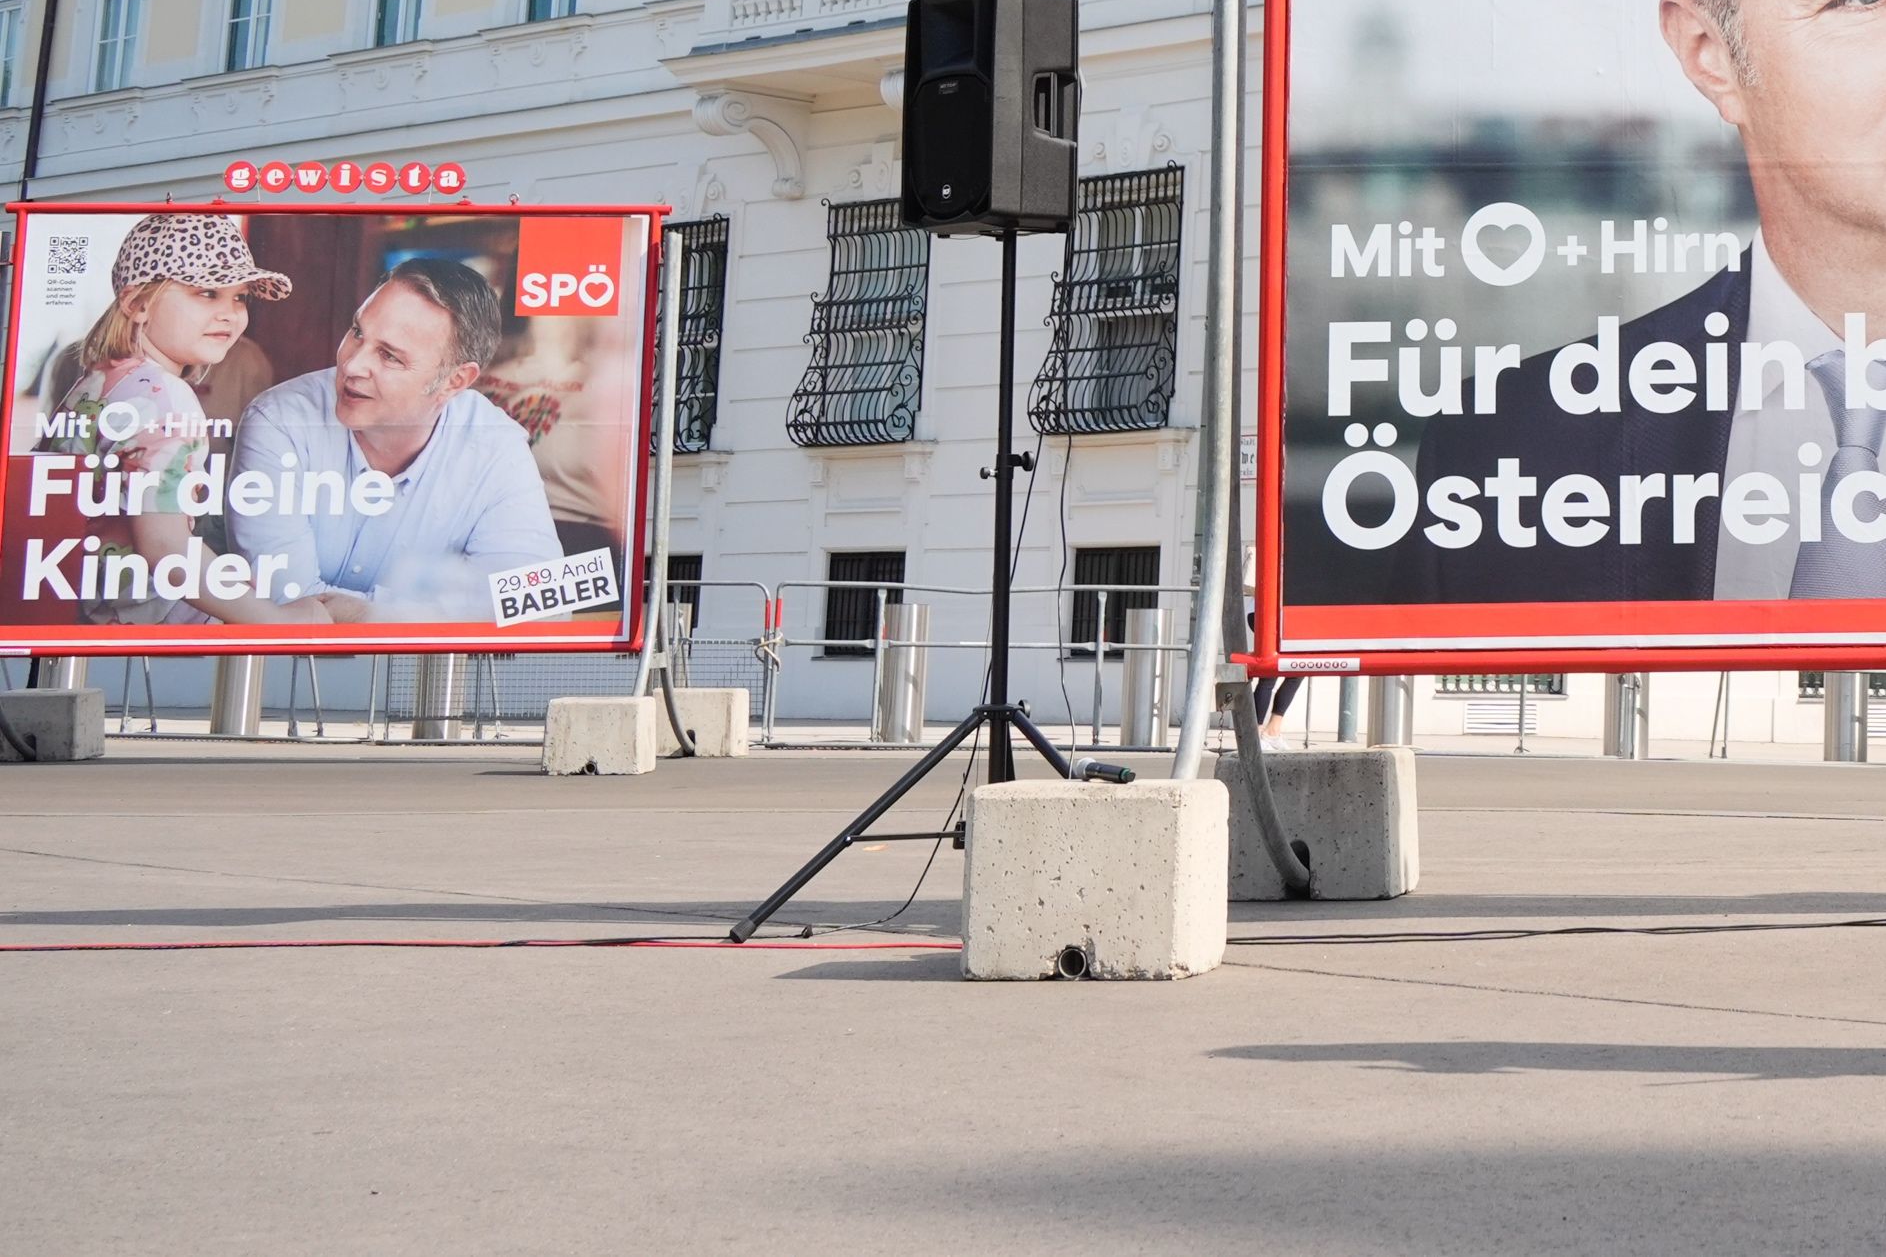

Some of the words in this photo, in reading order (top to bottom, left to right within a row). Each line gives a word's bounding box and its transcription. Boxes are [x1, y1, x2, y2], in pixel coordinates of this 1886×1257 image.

[231, 163, 460, 188] gewista
[1330, 220, 1446, 278] Mit
[1600, 216, 1742, 275] Hirn
[521, 264, 615, 308] SPÖ
[1328, 318, 1521, 418] Für
[1548, 311, 1806, 415] dein
[34, 410, 92, 439] Mit
[165, 410, 233, 439] Hirn
[29, 453, 160, 517] Für
[176, 451, 395, 517] deine
[22, 535, 301, 601] Kinder.
[562, 556, 604, 580] Andi
[501, 576, 611, 619] BABLER
